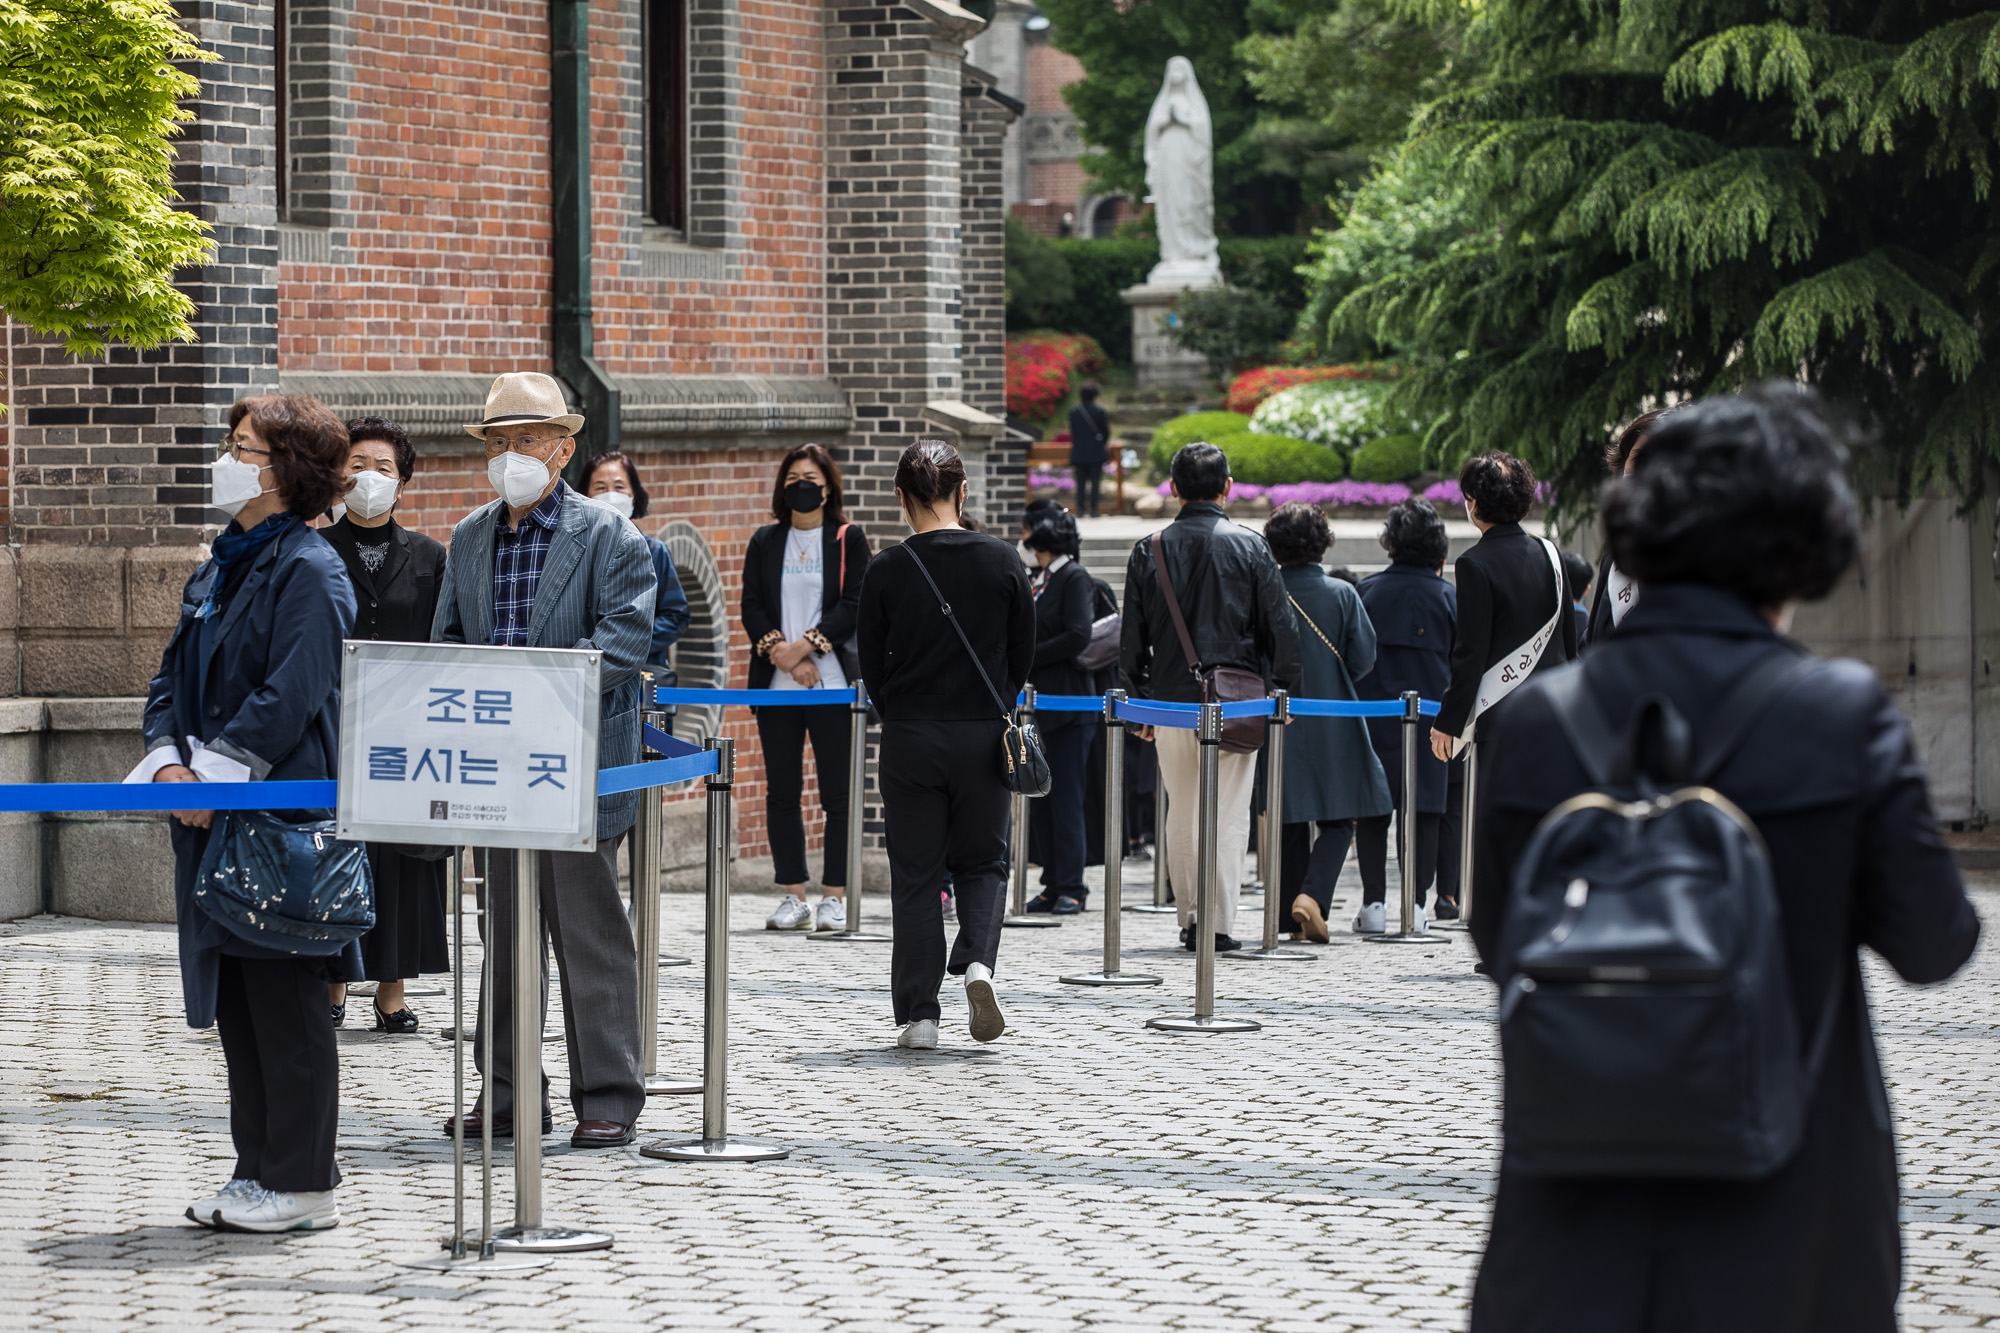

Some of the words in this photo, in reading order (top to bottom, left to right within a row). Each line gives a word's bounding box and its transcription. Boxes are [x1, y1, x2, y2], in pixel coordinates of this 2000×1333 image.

[427, 687, 512, 725] 조문
[368, 746, 498, 785] 줄서는
[528, 753, 567, 790] 곳
